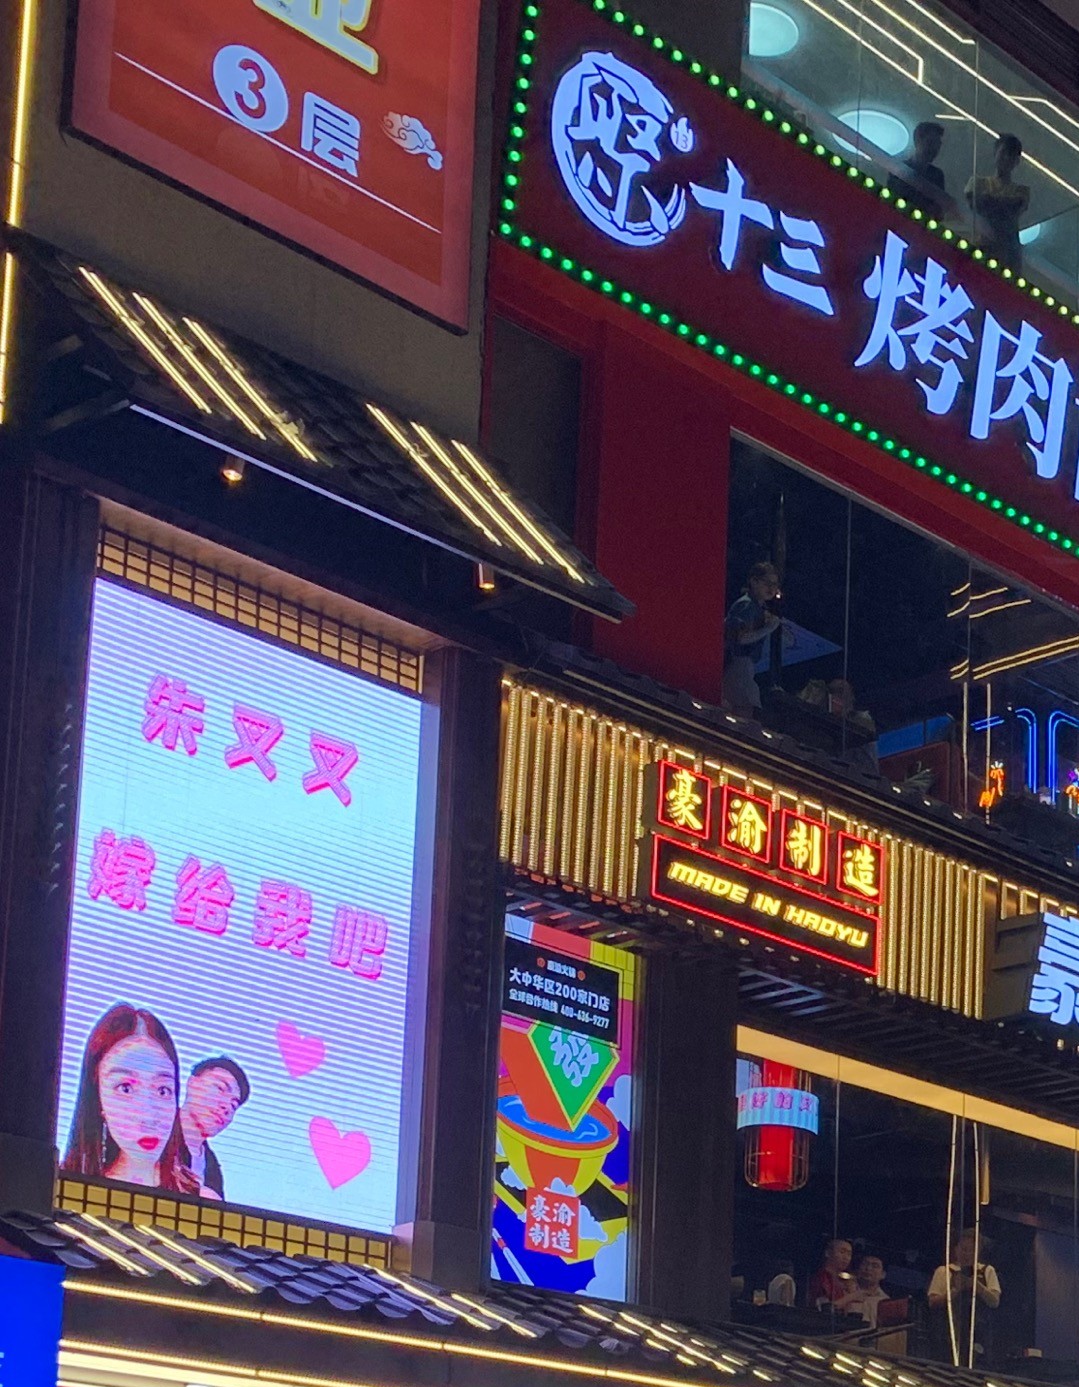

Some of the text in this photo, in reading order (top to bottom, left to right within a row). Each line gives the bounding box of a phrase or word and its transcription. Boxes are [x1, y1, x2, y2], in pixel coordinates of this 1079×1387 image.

[666, 769, 879, 896] 豪渝制造
[87, 826, 389, 980] 嫁给我吧
[667, 861, 869, 948] MADE IN HAOYU
[509, 967, 610, 1012] 大中华区200家门店
